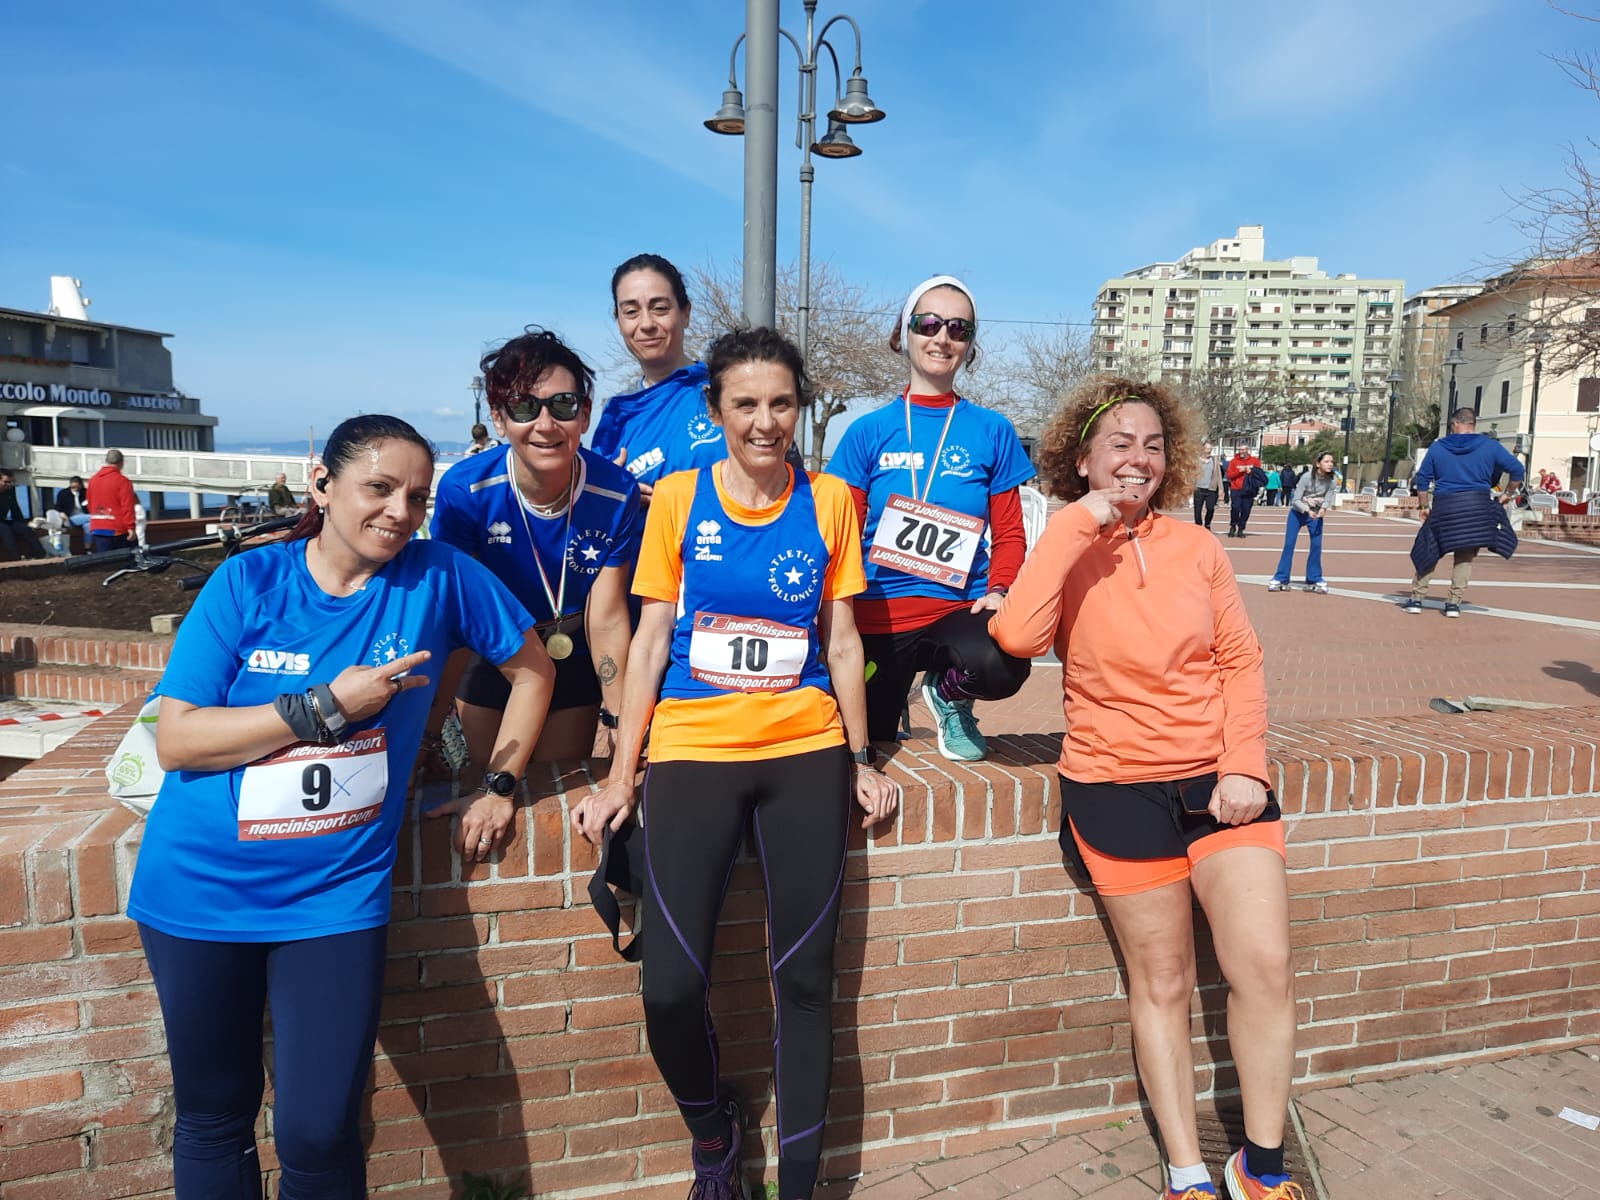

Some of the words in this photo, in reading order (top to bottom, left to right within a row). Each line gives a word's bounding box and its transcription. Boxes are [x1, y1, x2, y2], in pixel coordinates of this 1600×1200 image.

[0, 382, 46, 402] colo
[50, 383, 112, 406] Mondo
[127, 396, 181, 411] ALBERGO
[879, 452, 924, 468] AVIS
[893, 499, 978, 529] nencinisport.com
[567, 529, 614, 554] ATLETIC
[895, 516, 962, 563] 202
[769, 549, 818, 575] ATLETICA
[873, 549, 940, 576] nencinisport
[768, 577, 818, 602] FOLLONICA
[727, 620, 805, 638] nencinisport
[248, 649, 310, 671] AVIS
[728, 636, 769, 672] 10
[698, 672, 793, 690] nencinisport.com
[302, 763, 332, 811] 9
[248, 808, 374, 836] nencinisport.com
